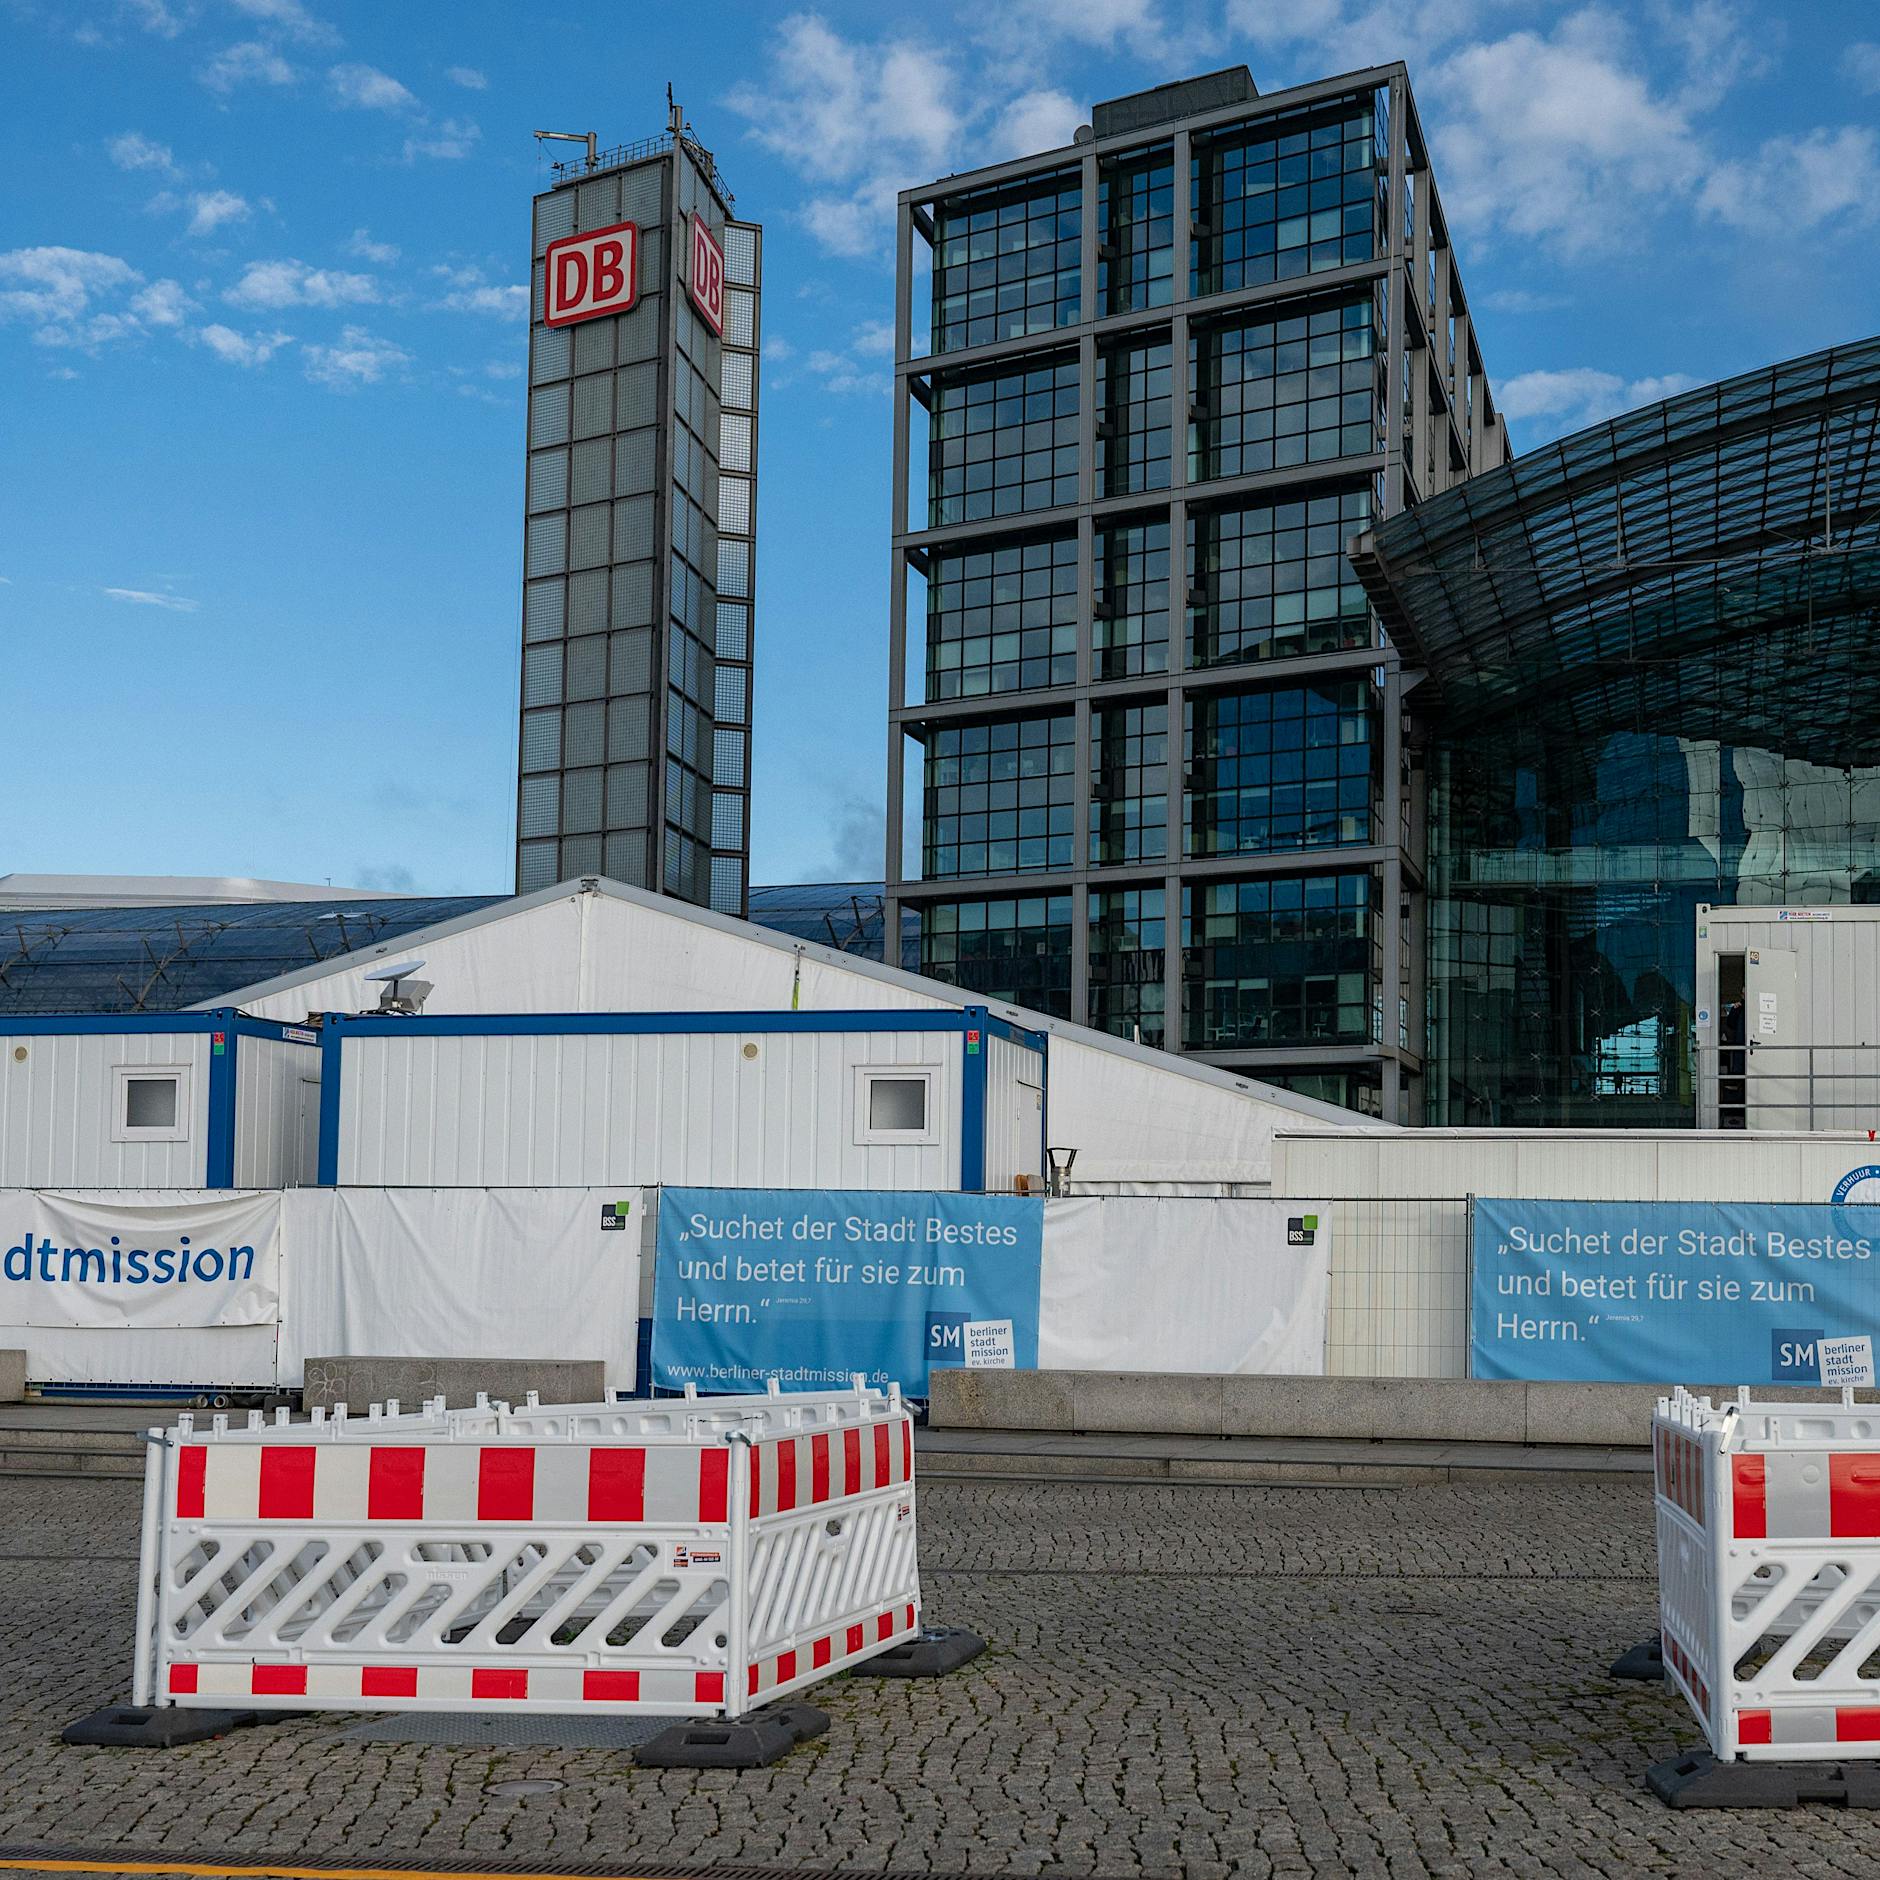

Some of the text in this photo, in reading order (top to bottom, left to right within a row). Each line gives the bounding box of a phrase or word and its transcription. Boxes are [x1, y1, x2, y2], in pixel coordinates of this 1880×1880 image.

[556, 239, 624, 312] DB
[696, 231, 720, 316] DB
[1836, 1168, 1871, 1197] VERHUUR
[603, 1216, 616, 1227] BSS
[679, 1213, 1017, 1246] „Suchet der Stadt Bestes
[1289, 1230, 1304, 1242] BSS
[1497, 1226, 1871, 1259] „Suchet der Stadt Bestes
[4, 1232, 255, 1285] dtmission
[678, 1255, 965, 1287] und betet für sie zum
[1498, 1269, 1814, 1302] und betet für sie zum
[931, 1324, 960, 1348] SM
[970, 1326, 1008, 1337] berliner
[970, 1337, 996, 1347] stadt
[1824, 1343, 1865, 1355] berliner
[971, 1347, 1009, 1357] mission
[1780, 1343, 1814, 1367] SM
[1825, 1354, 1854, 1366] stadt
[983, 1357, 1005, 1366] kirche
[1827, 1365, 1868, 1377] mission
[1840, 1375, 1865, 1384] kirche
